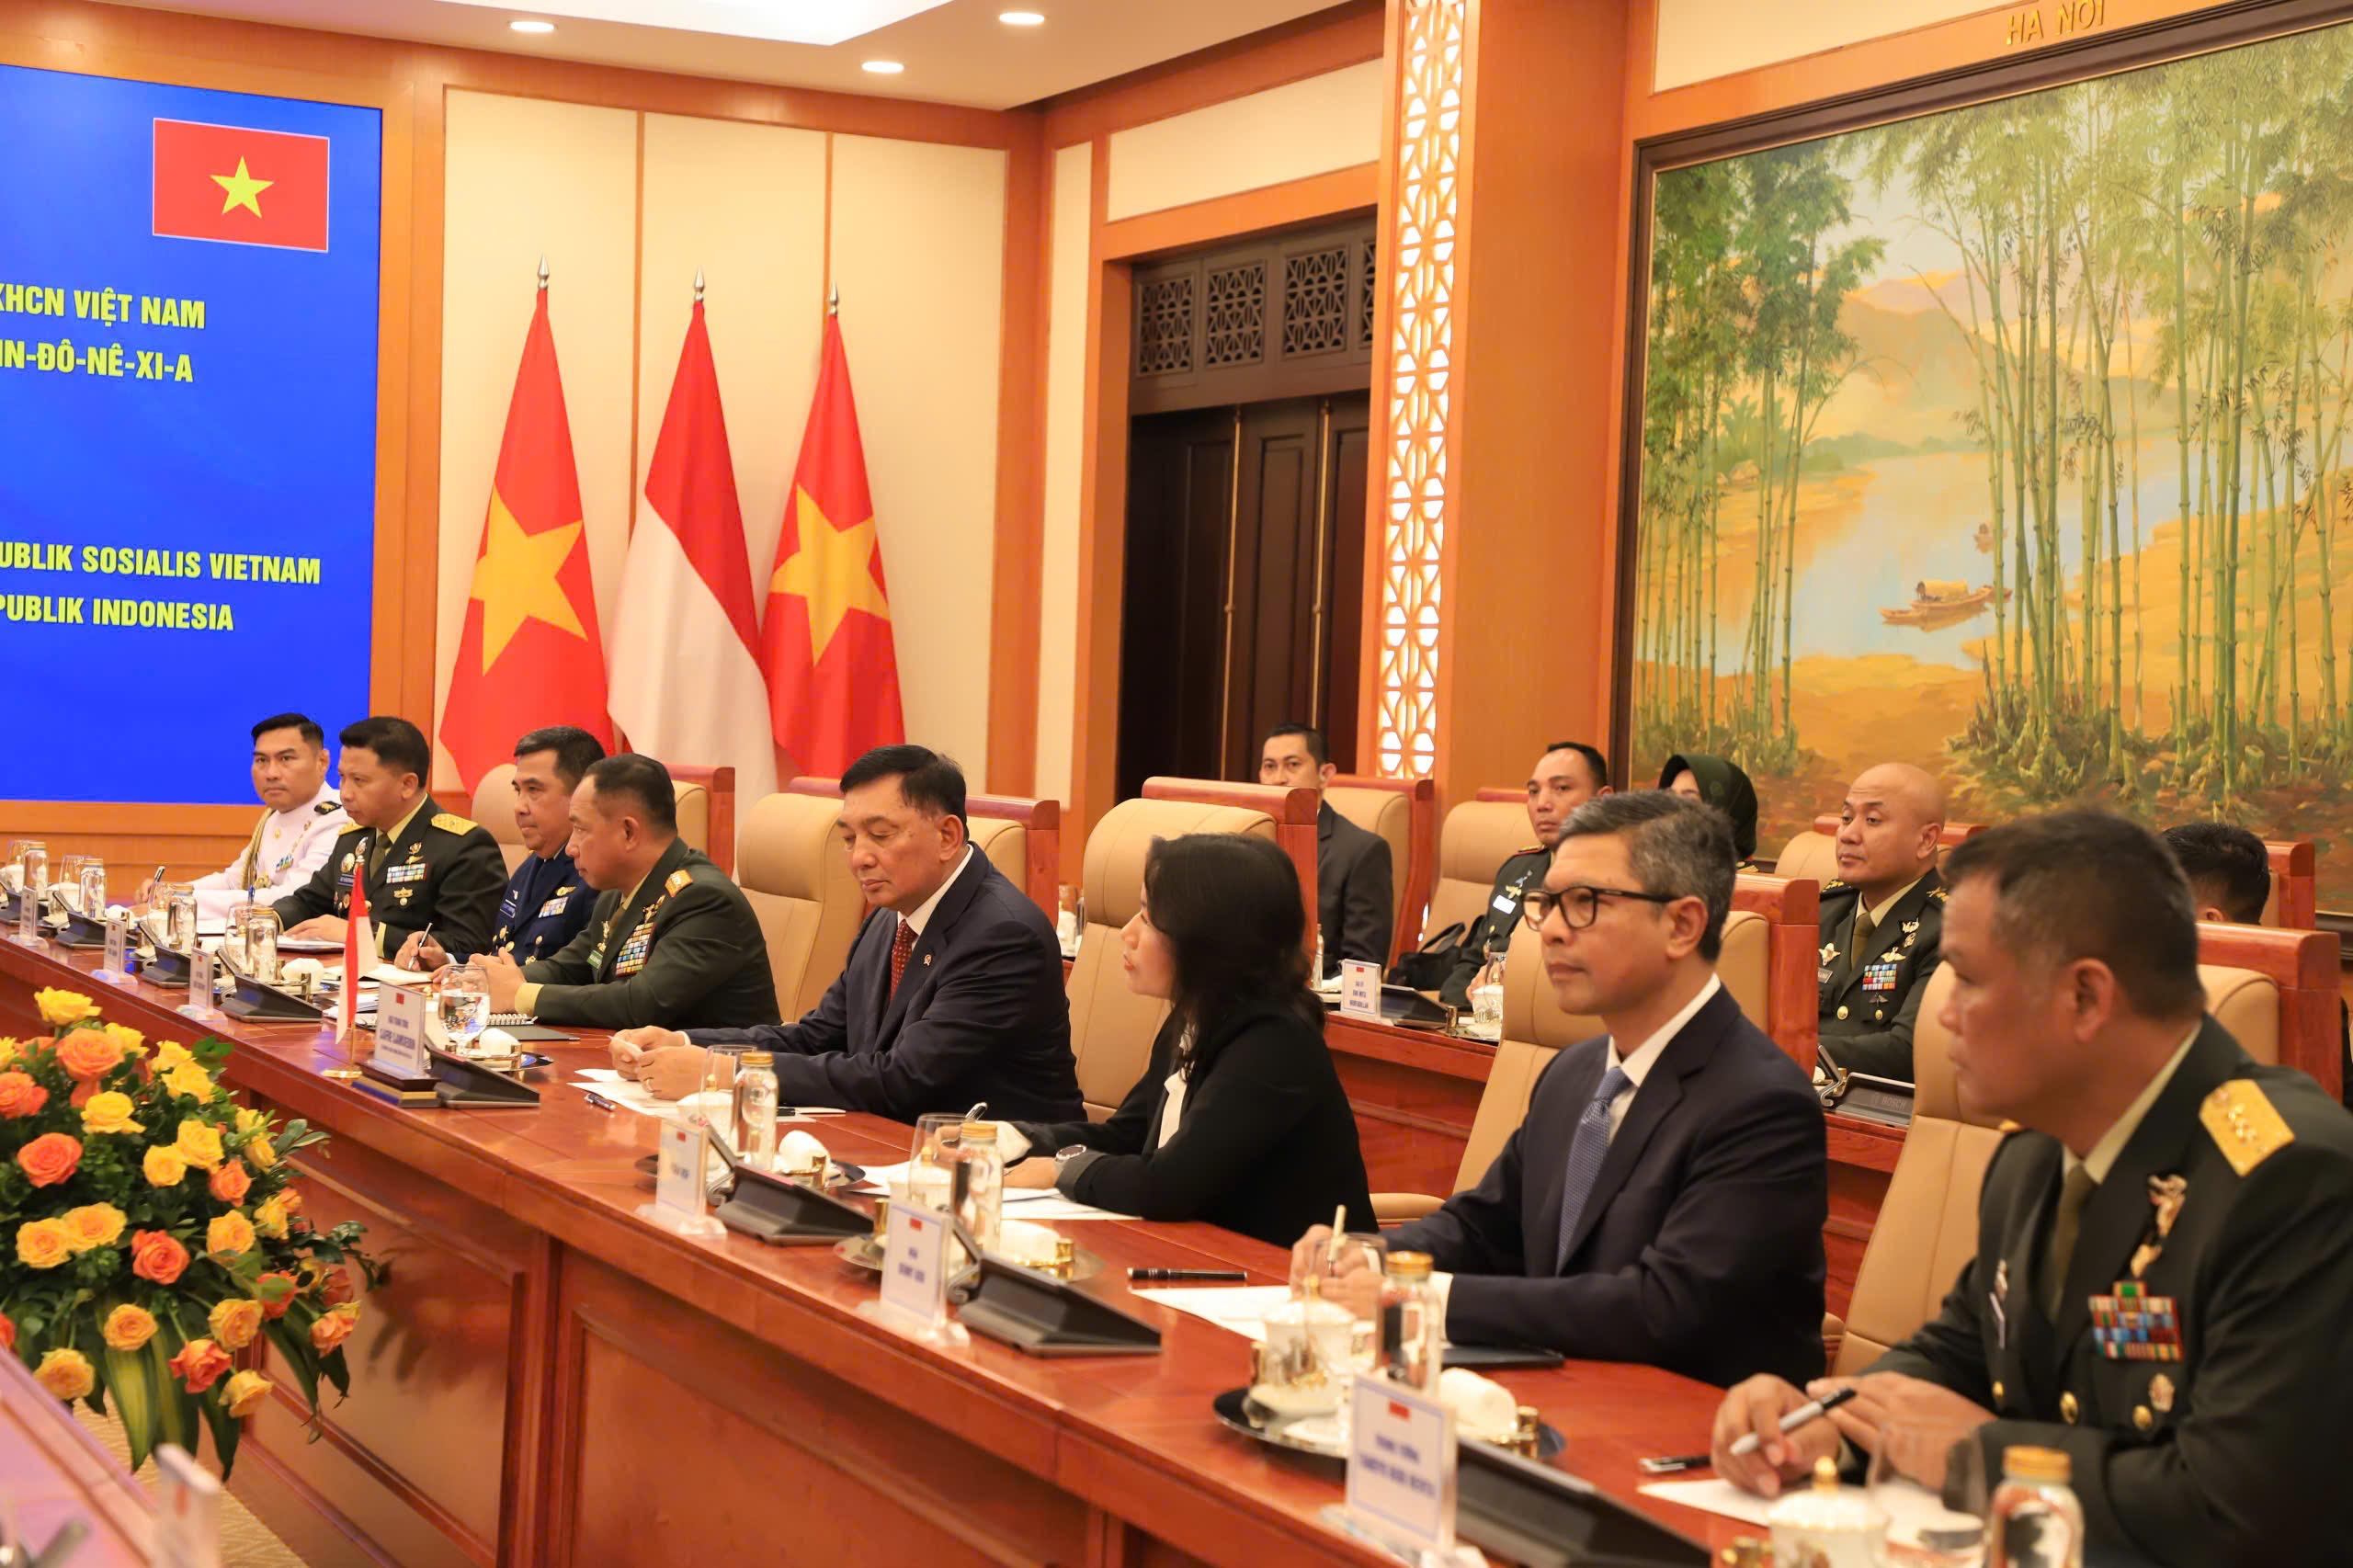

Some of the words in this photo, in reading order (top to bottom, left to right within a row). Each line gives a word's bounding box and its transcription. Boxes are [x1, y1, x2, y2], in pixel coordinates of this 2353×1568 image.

[73, 287, 133, 327] VIỆT
[141, 296, 206, 329] NAM
[82, 545, 201, 578] SOSIALIS
[209, 552, 321, 585] VIETNAM
[92, 598, 234, 631] INDONESIA
